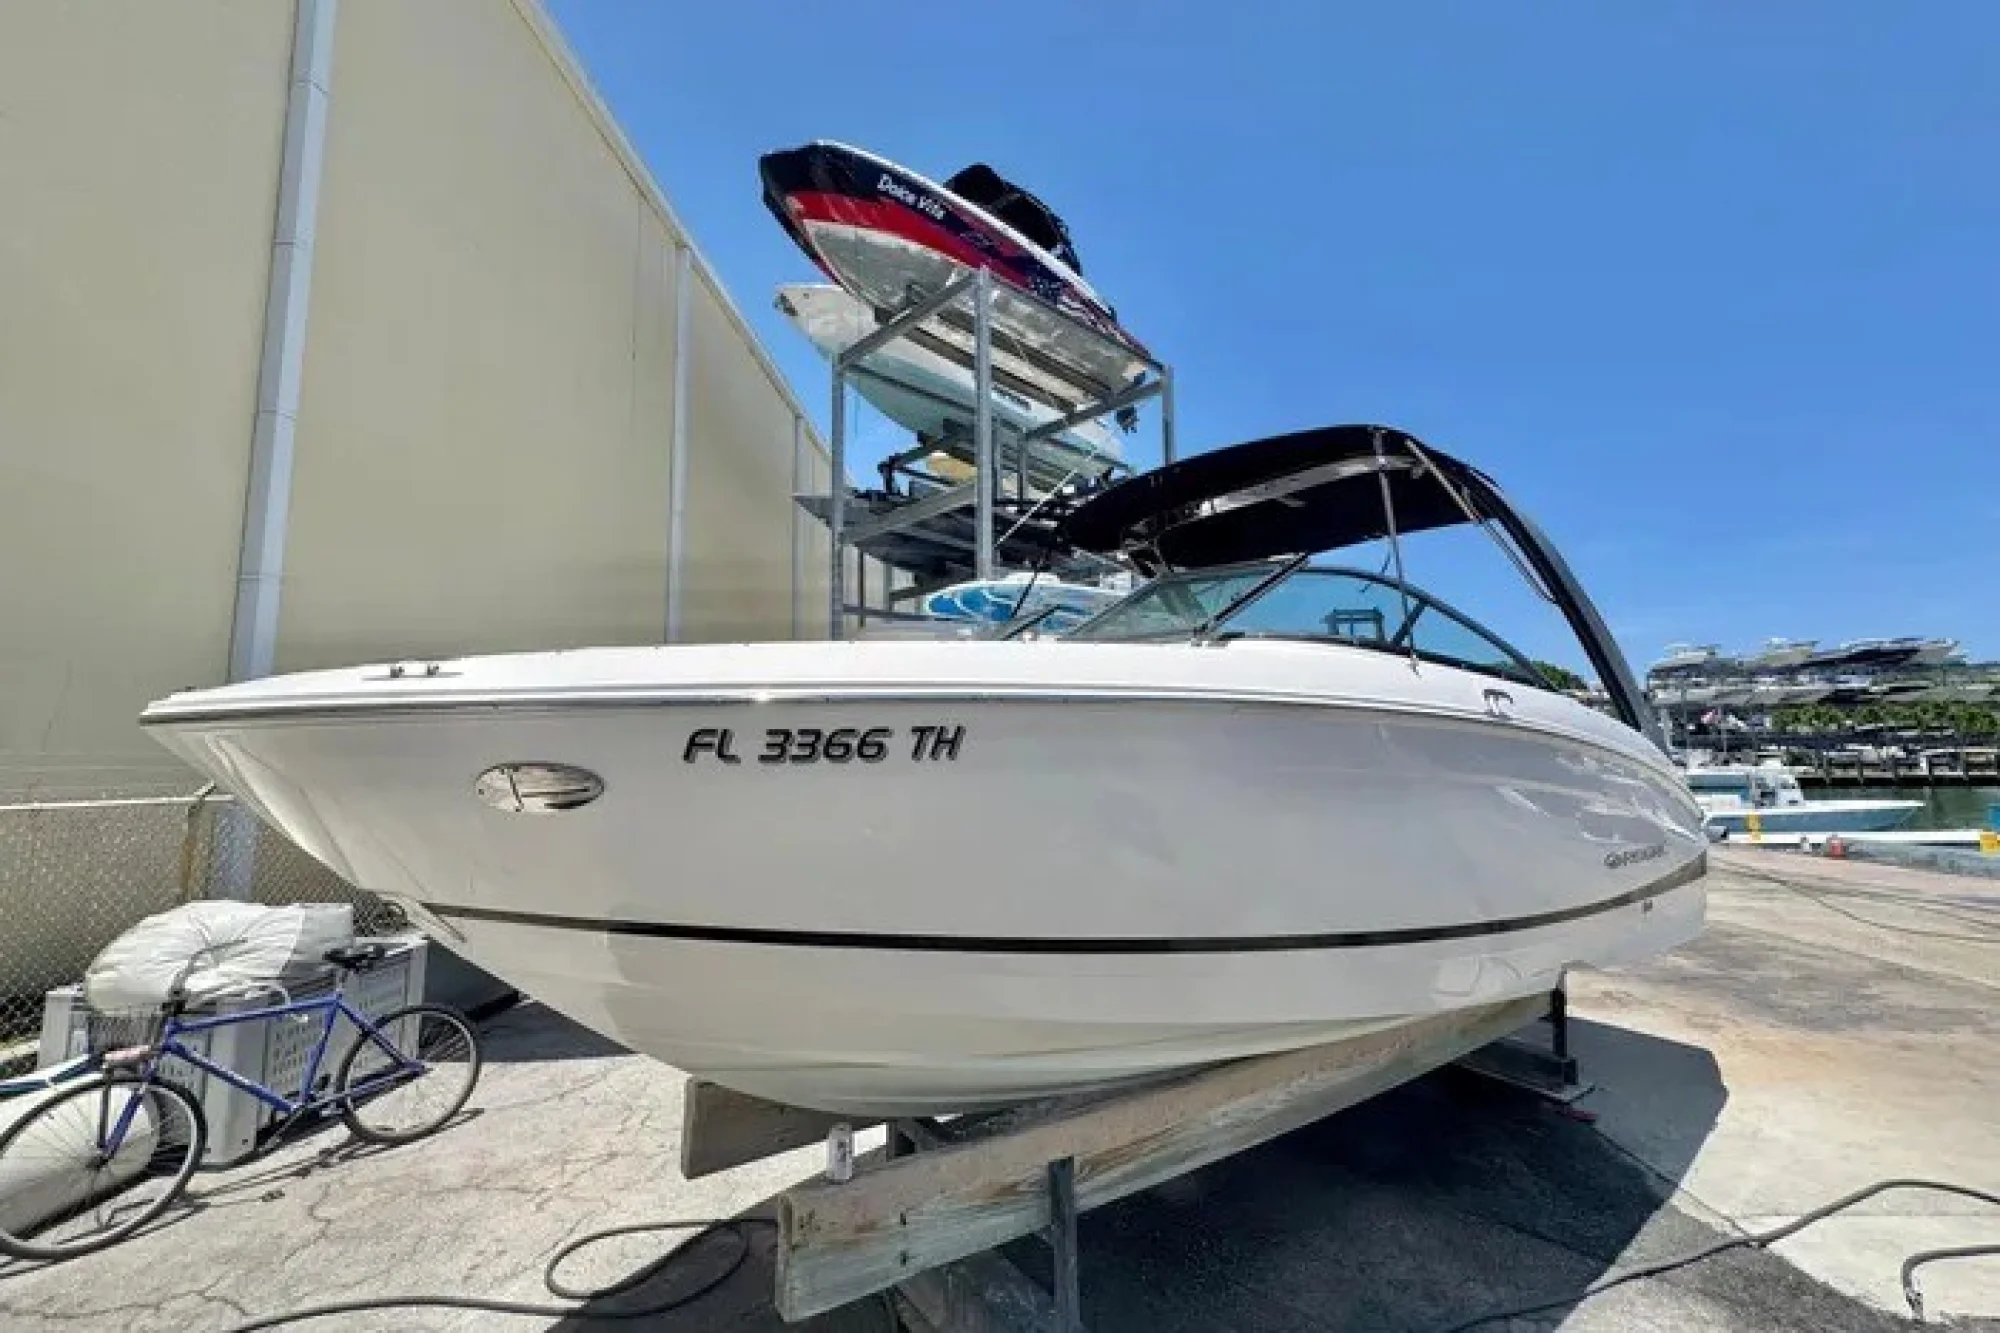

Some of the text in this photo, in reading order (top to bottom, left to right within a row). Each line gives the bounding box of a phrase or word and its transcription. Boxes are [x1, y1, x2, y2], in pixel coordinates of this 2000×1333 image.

[683, 724, 966, 764] FL 3366 TH
